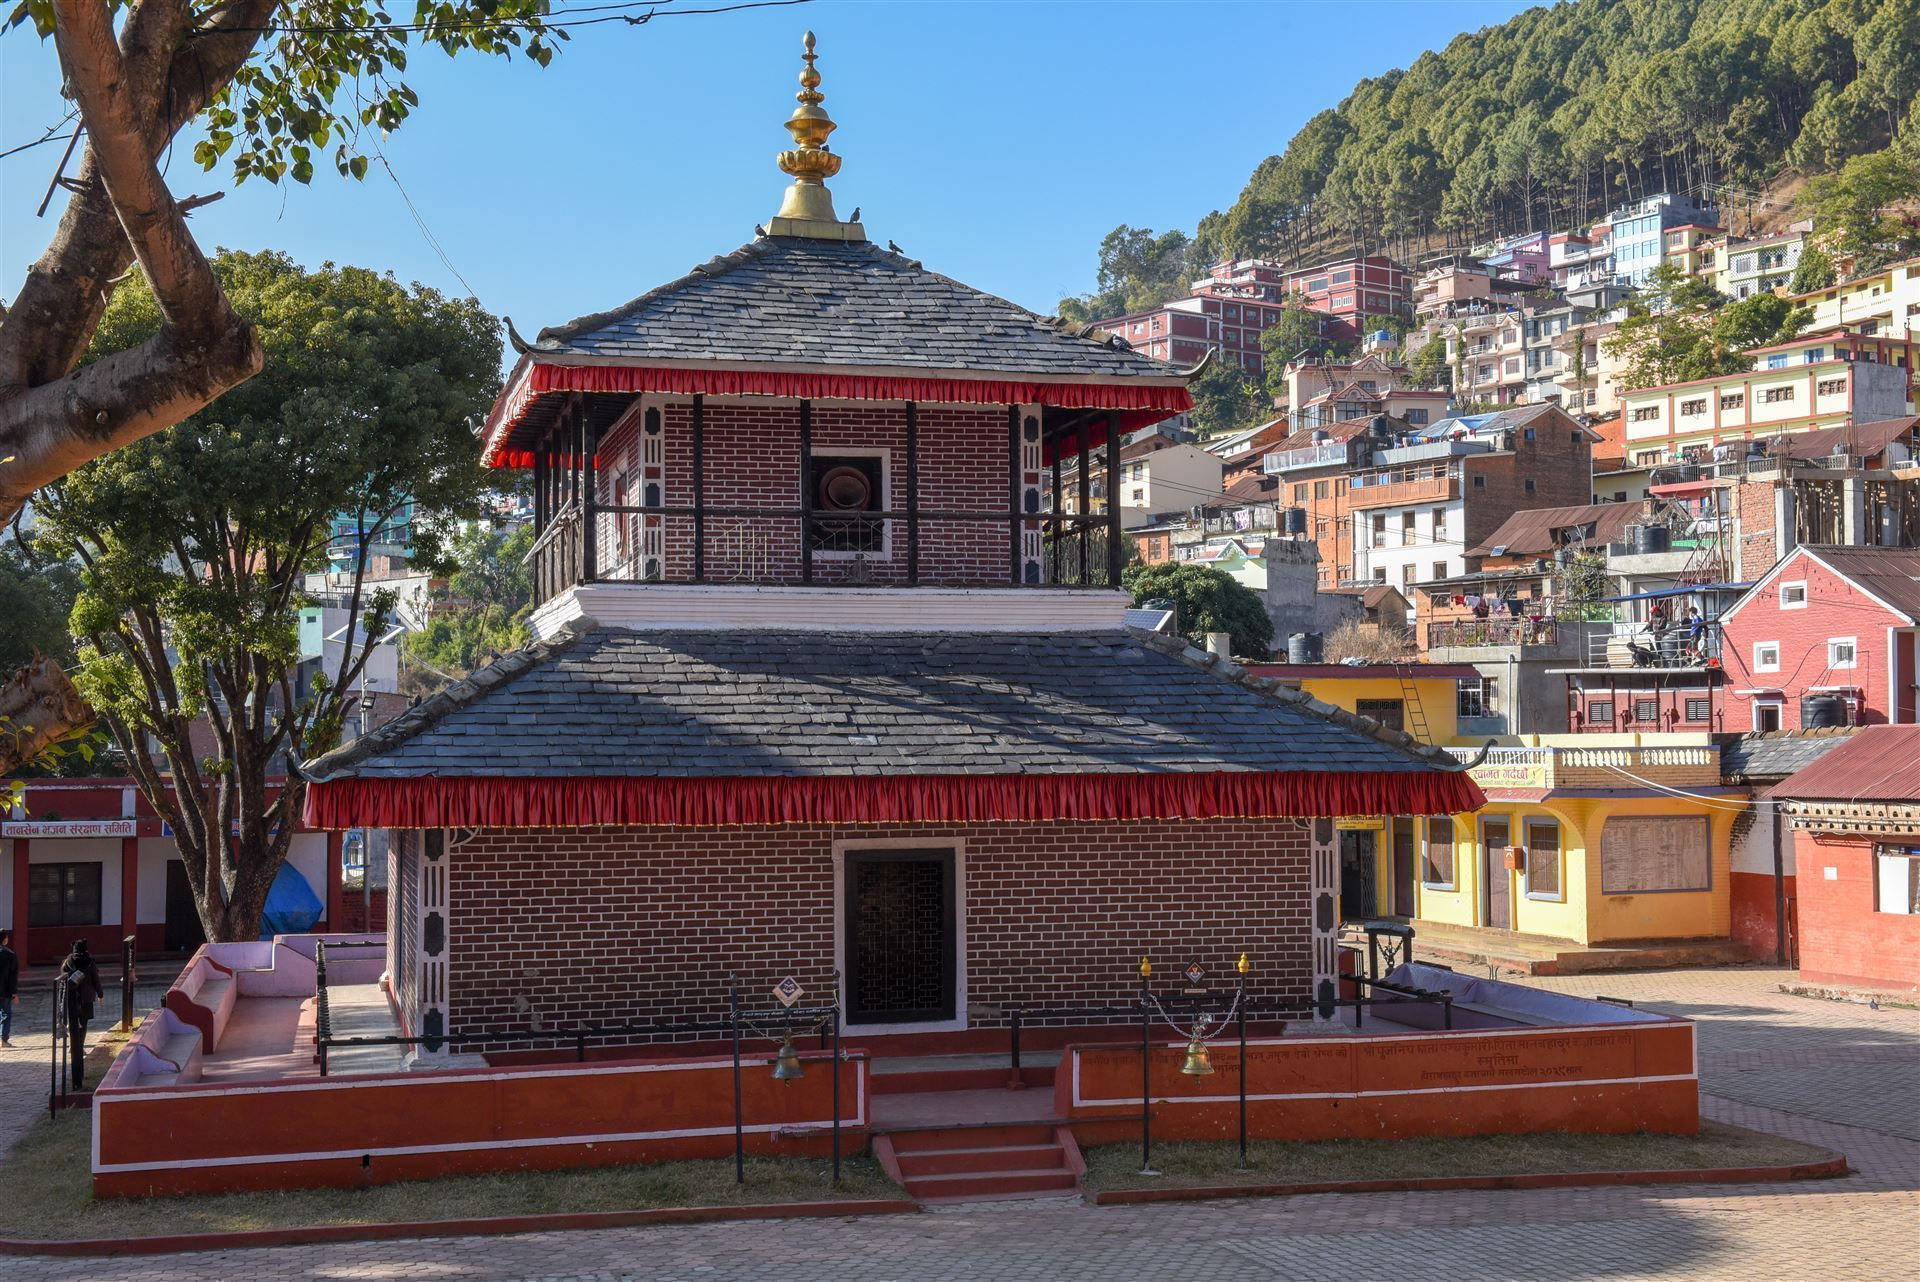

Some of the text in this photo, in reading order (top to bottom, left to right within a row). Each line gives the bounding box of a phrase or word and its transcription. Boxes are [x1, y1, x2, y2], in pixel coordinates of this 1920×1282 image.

[1473, 769, 1499, 779] स्वागत
[6, 821, 132, 835] तानसेन भजन संरक्षण समिति
